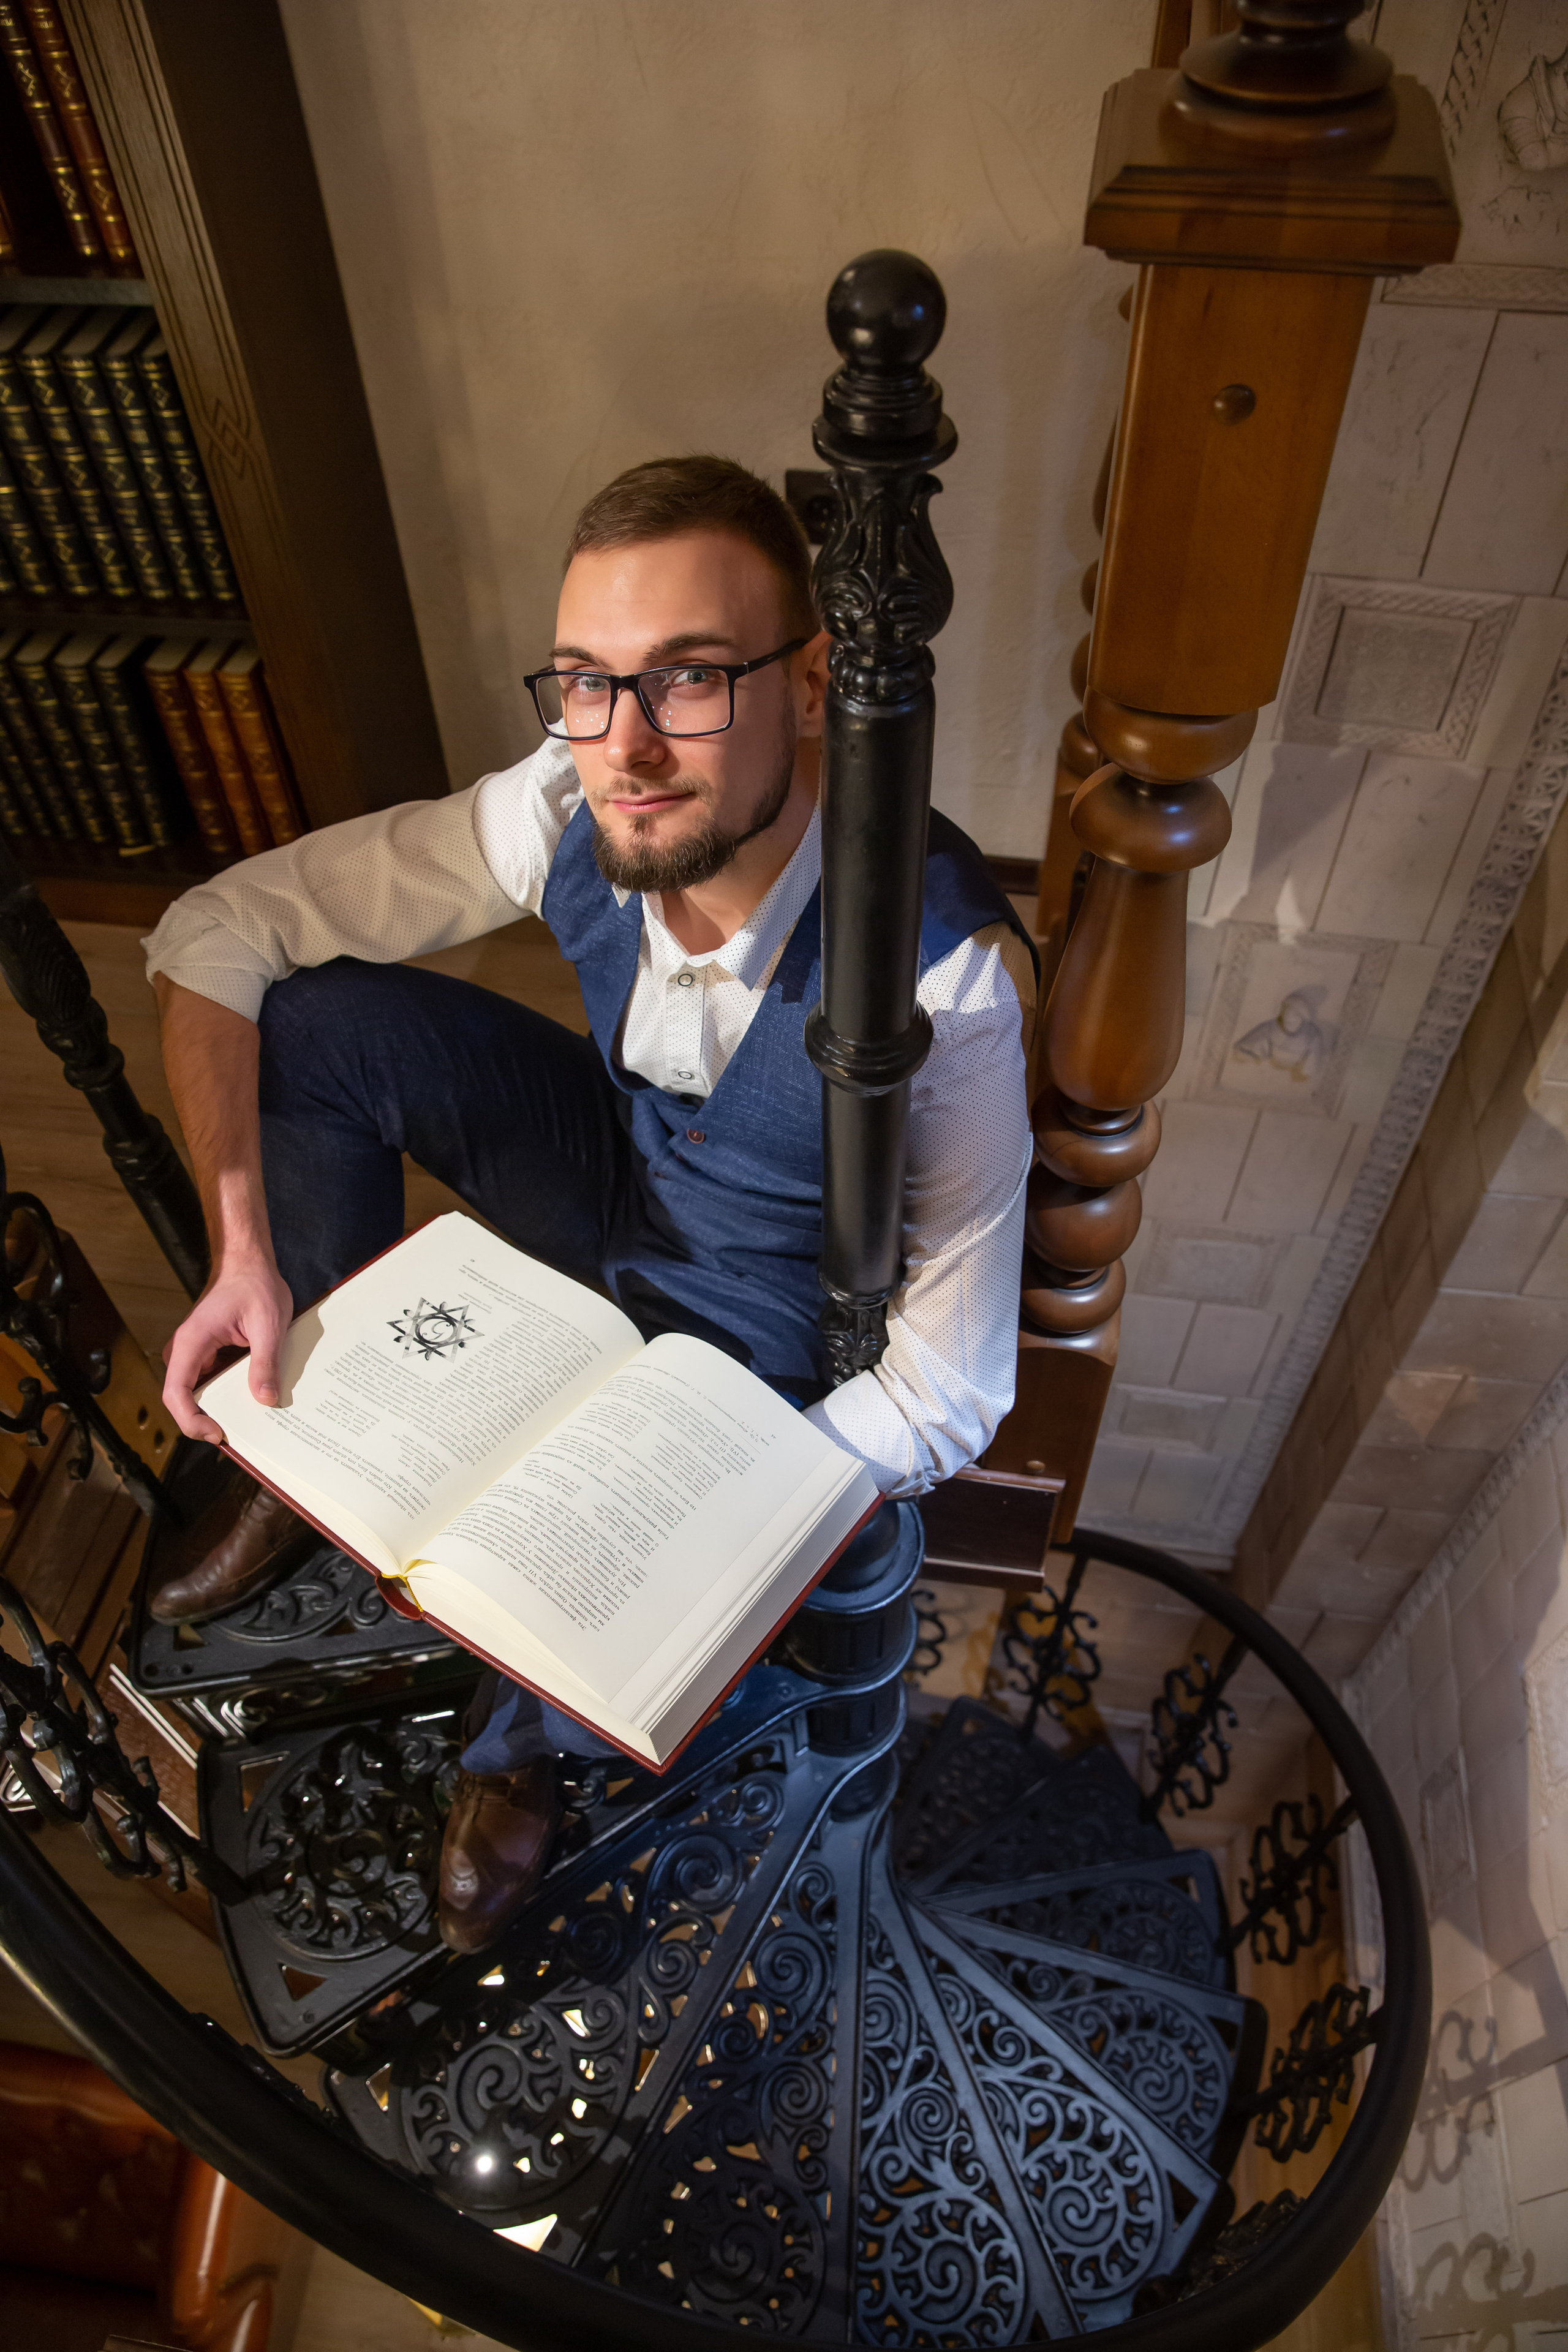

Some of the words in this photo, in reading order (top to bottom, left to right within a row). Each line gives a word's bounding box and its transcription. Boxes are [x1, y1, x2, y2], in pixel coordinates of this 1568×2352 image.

[579, 1536, 590, 1545] себя
[597, 1532, 616, 1549] случайно
[479, 1543, 507, 1562] характерная
[576, 1551, 590, 1565] частью
[507, 1561, 521, 1573] самая
[518, 1559, 528, 1570] тома
[522, 1573, 537, 1586] жилка
[562, 1587, 578, 1602] искали
[602, 1594, 620, 1610] ческими
[578, 1601, 598, 1620] напрасно
[578, 1621, 587, 1631] Эта
